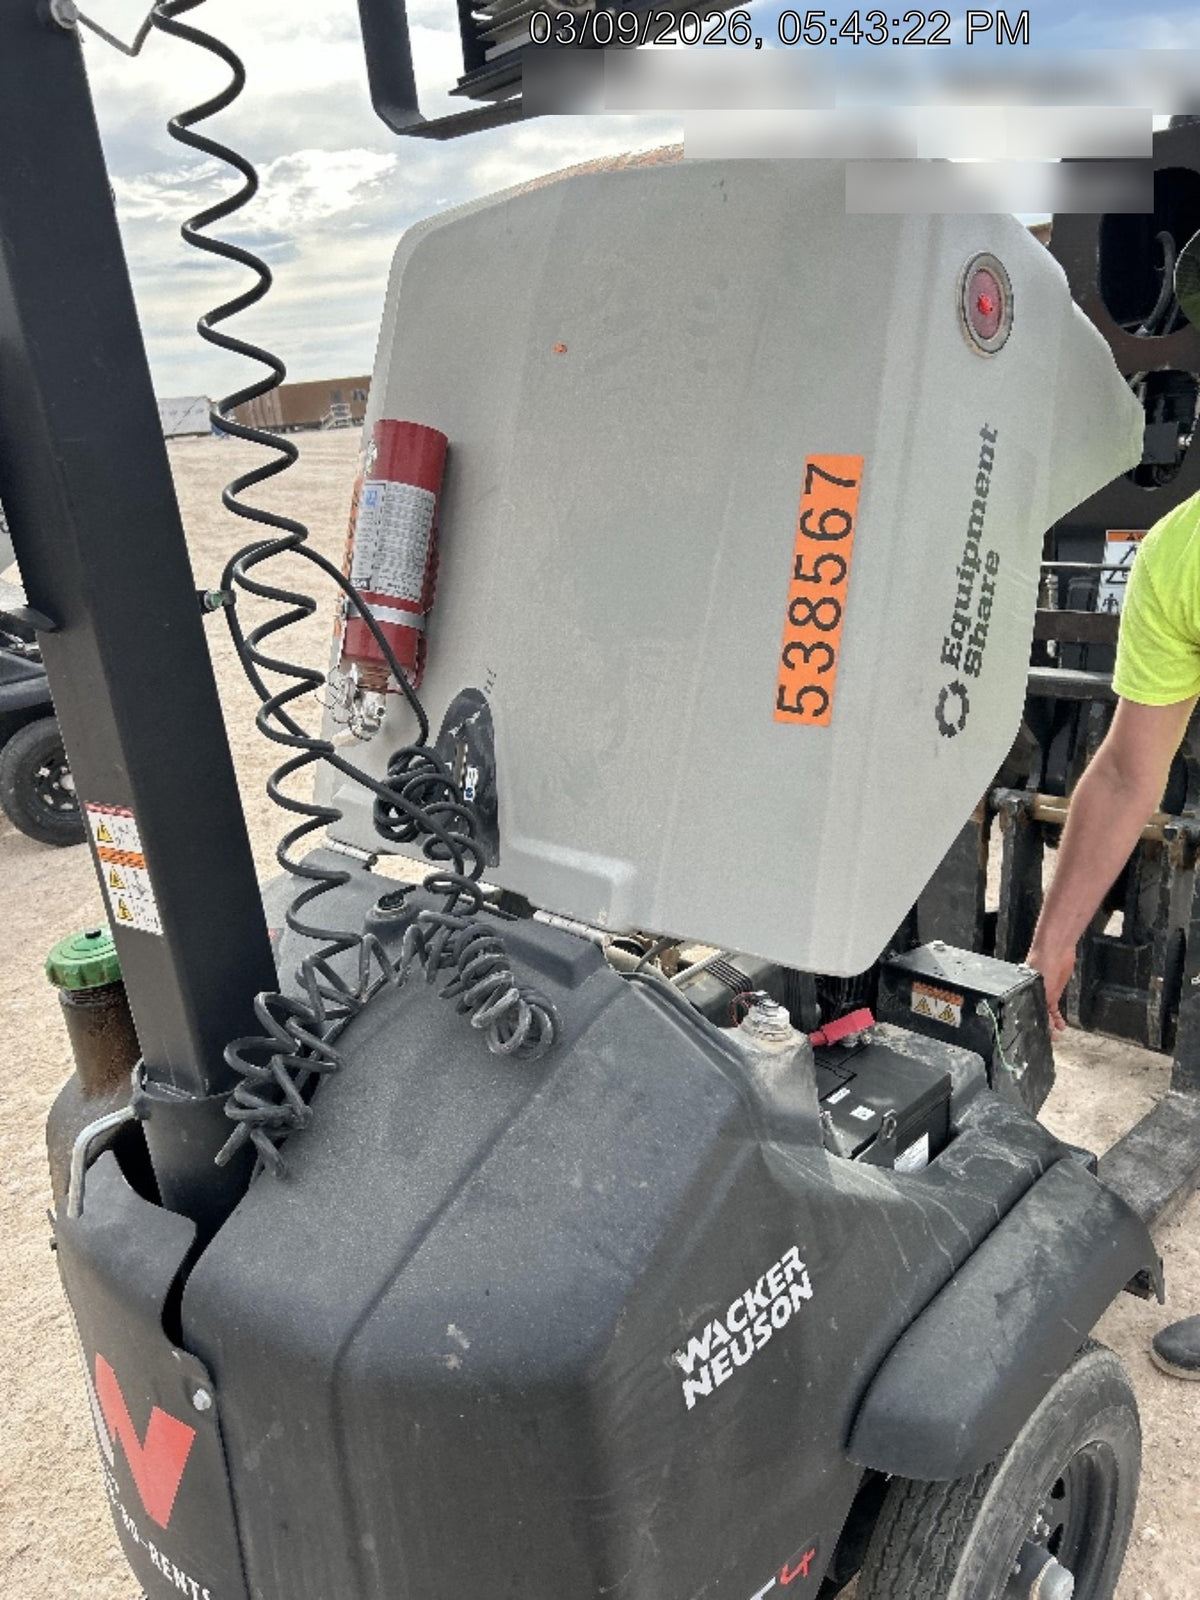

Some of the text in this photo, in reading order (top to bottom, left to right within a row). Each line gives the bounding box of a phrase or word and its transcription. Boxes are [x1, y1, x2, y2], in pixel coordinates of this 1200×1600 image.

[777, 463, 856, 717] 538567
[940, 422, 998, 670] Equipment
[963, 549, 1000, 678] Share
[673, 1245, 806, 1374] WACKER
[682, 1270, 813, 1410] NEUSON
